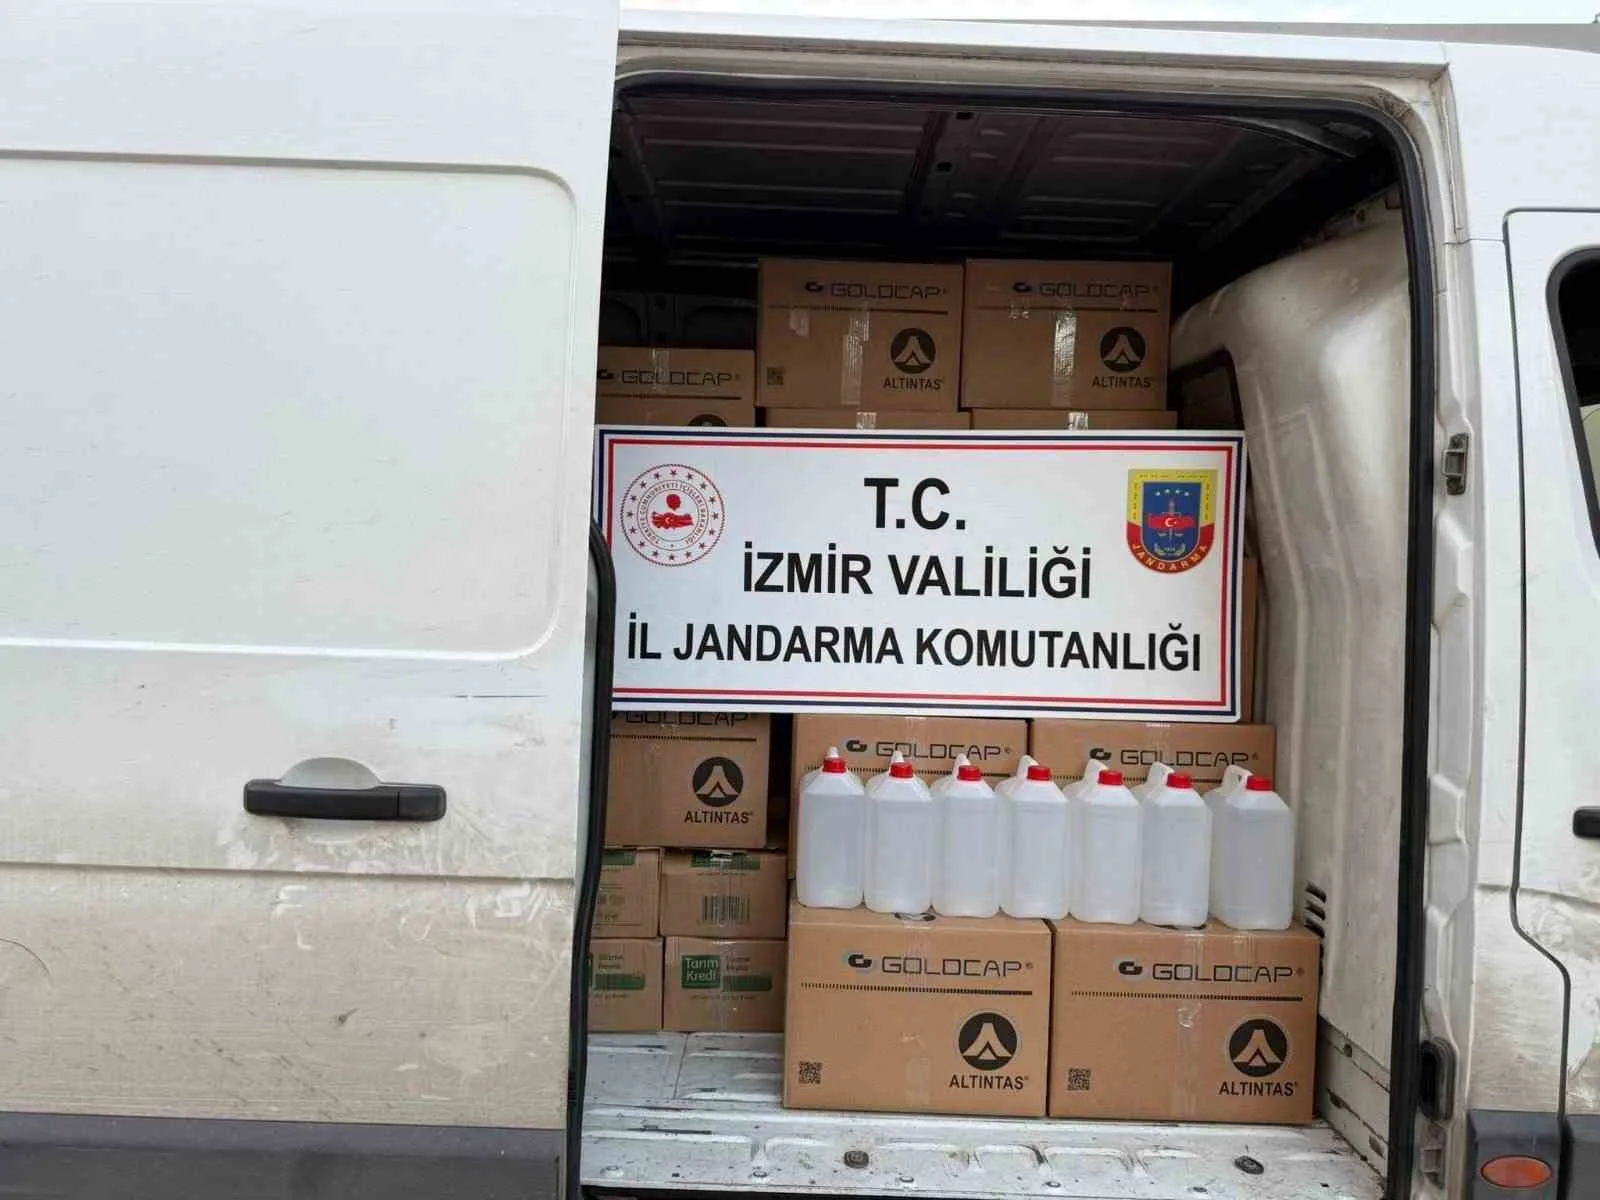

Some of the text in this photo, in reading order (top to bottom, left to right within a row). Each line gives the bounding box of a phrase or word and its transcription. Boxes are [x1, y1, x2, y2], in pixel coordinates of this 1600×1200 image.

[863, 476, 967, 532] T.C.
[742, 540, 1092, 599] İZMİR VALİLİĞİ
[1132, 543, 1208, 571] JANDARMA
[627, 612, 1201, 672] İL JANDARMA KOMUTANLIĞI
[949, 1074, 1024, 1090] ALTINTAS
[1219, 1081, 1294, 1097] ALTINTAS
